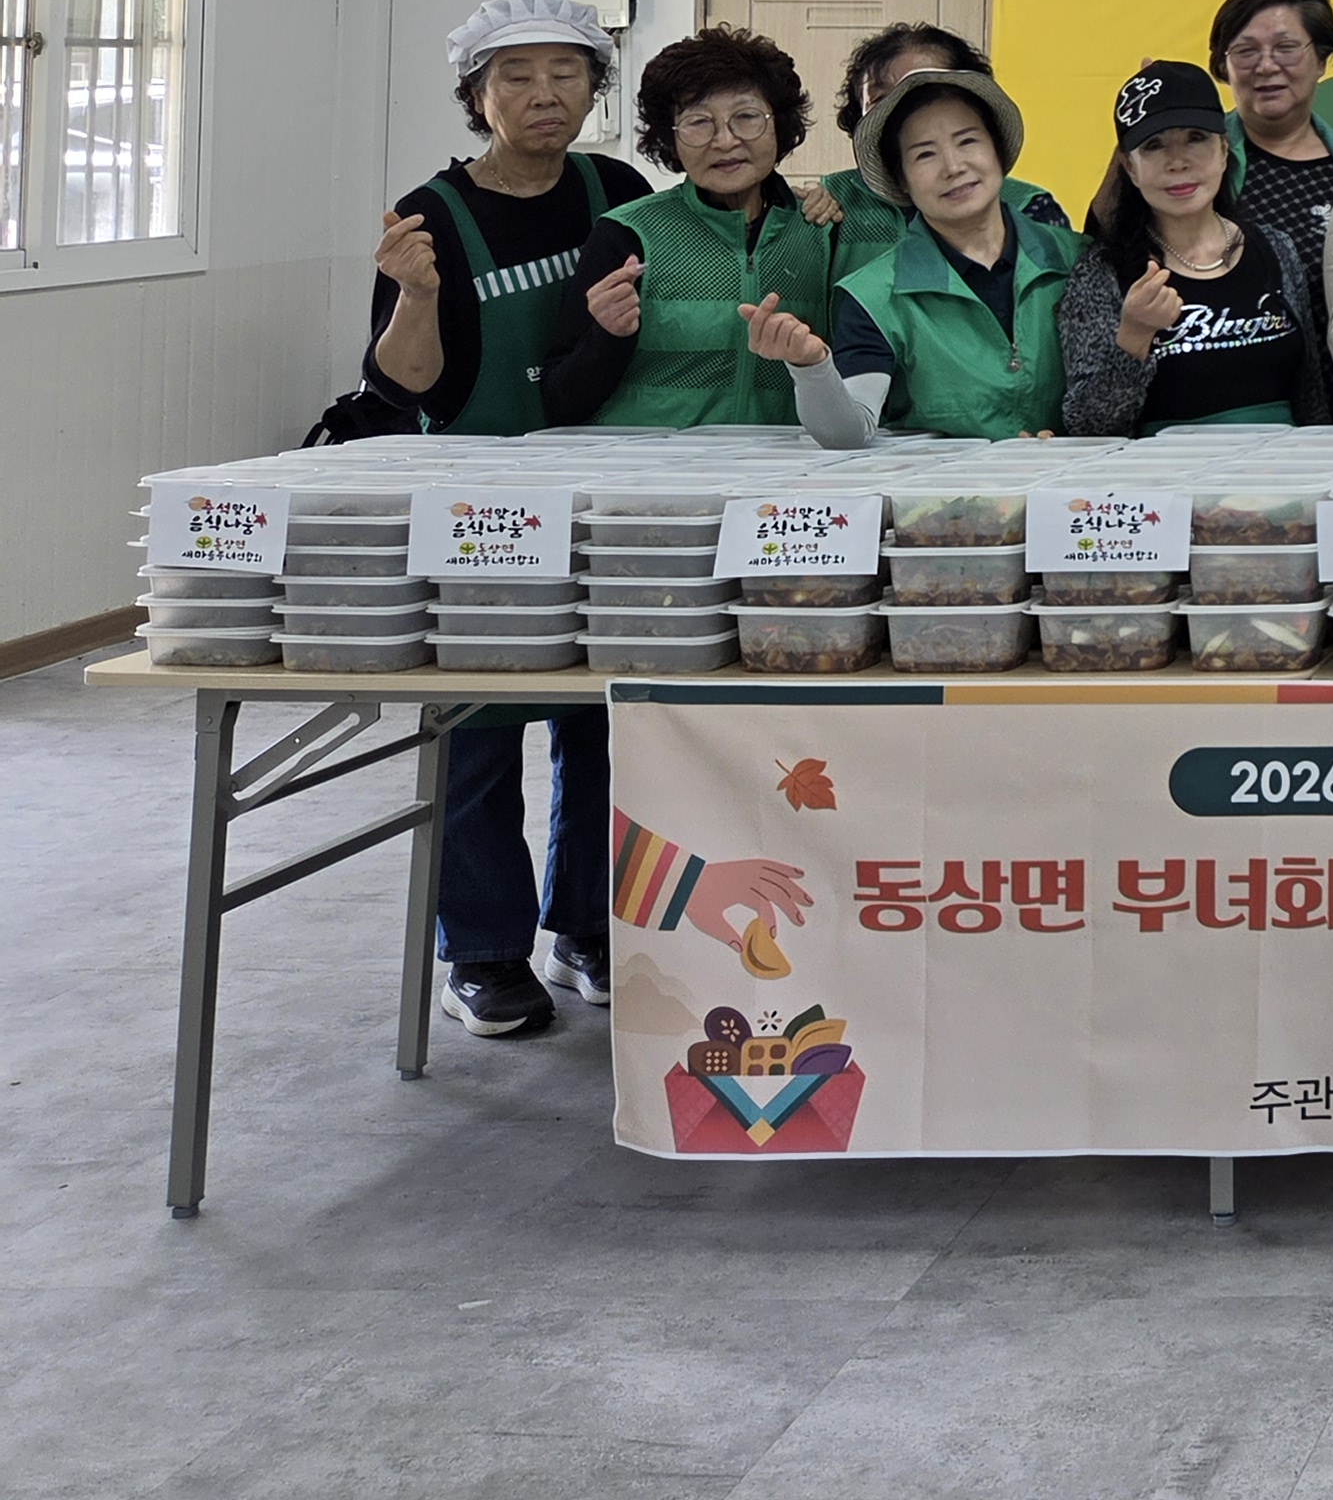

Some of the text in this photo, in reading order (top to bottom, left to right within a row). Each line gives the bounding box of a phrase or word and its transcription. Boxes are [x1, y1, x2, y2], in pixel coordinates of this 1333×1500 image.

[202, 499, 257, 515] 추석맞이
[463, 504, 526, 520] 추석맞이
[768, 504, 832, 520] 추석맞이
[1081, 501, 1145, 516] 추석맞이
[189, 515, 256, 535] 음식나눔
[452, 519, 525, 538] 음식나눔
[756, 519, 830, 539] 음식나눔
[1070, 515, 1143, 534] 음식나눔
[852, 858, 1086, 934] 동상면
